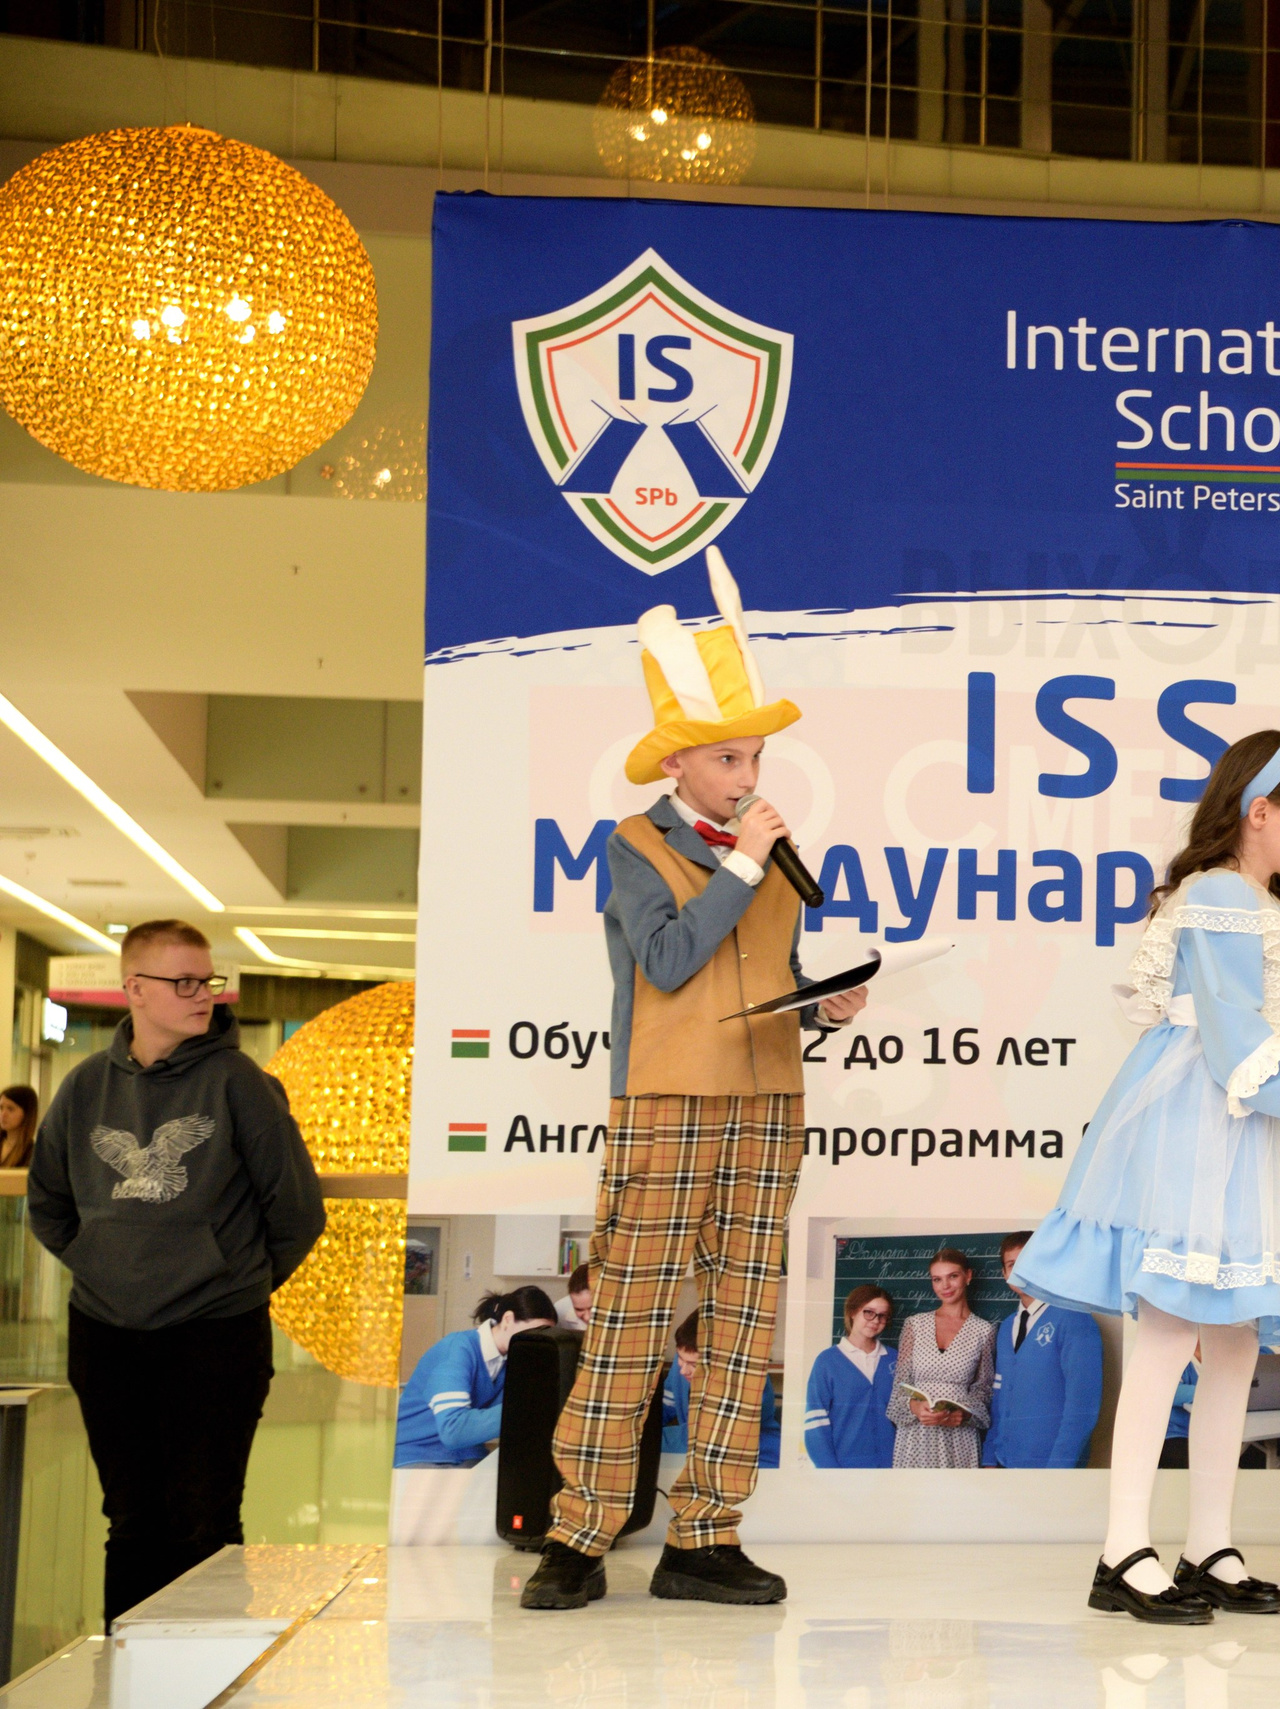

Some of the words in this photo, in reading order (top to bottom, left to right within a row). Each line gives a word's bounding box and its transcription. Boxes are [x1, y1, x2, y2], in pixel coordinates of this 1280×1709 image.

[618, 333, 694, 403] IS
[635, 486, 678, 507] SPb
[1114, 483, 1185, 510] Saint
[844, 1034, 904, 1070] до
[923, 1027, 981, 1065] 16
[996, 1037, 1077, 1067] лет
[504, 1114, 608, 1153] Англ
[803, 1126, 1064, 1167] программа
